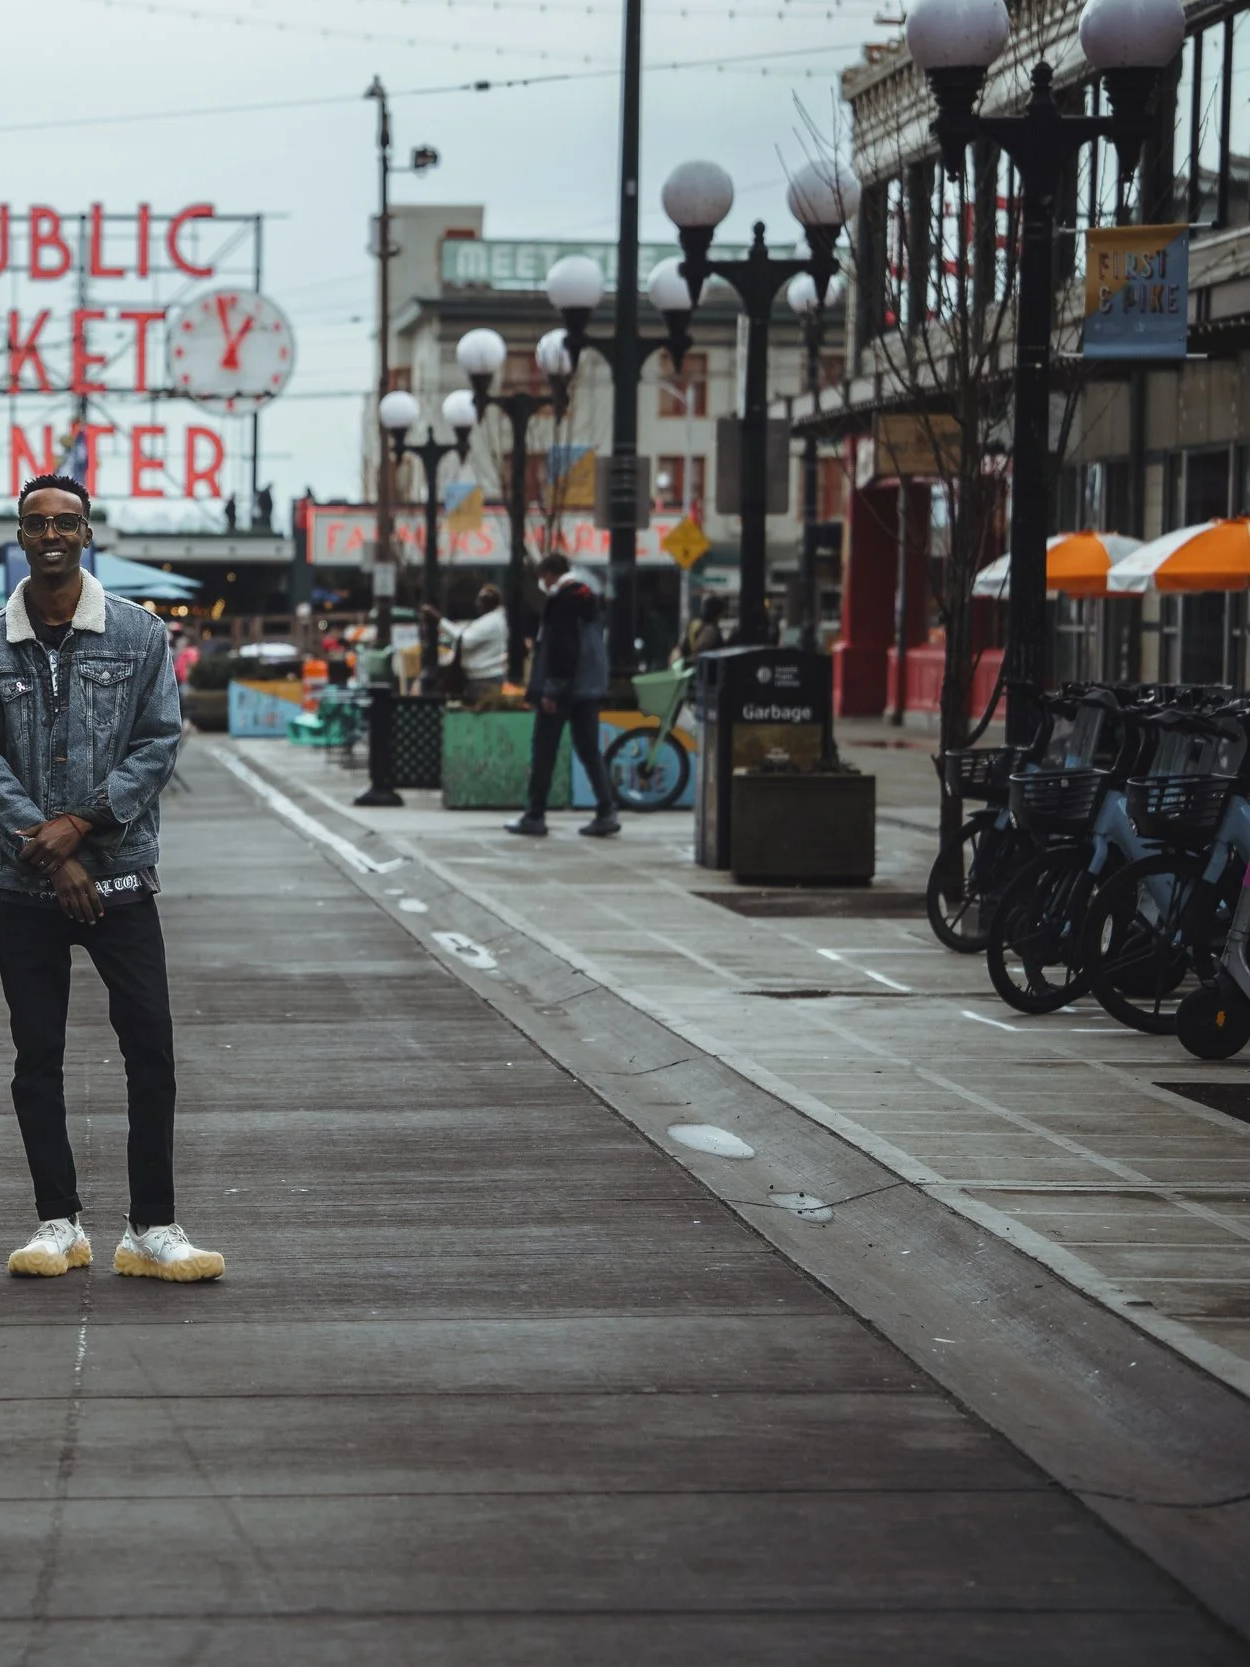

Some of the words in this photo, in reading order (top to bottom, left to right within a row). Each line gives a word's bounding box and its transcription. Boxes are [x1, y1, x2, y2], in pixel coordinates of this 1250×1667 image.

[1098, 249, 1167, 280] FIRST
[1122, 284, 1179, 314] PIKE
[742, 704, 812, 723] Garbage
